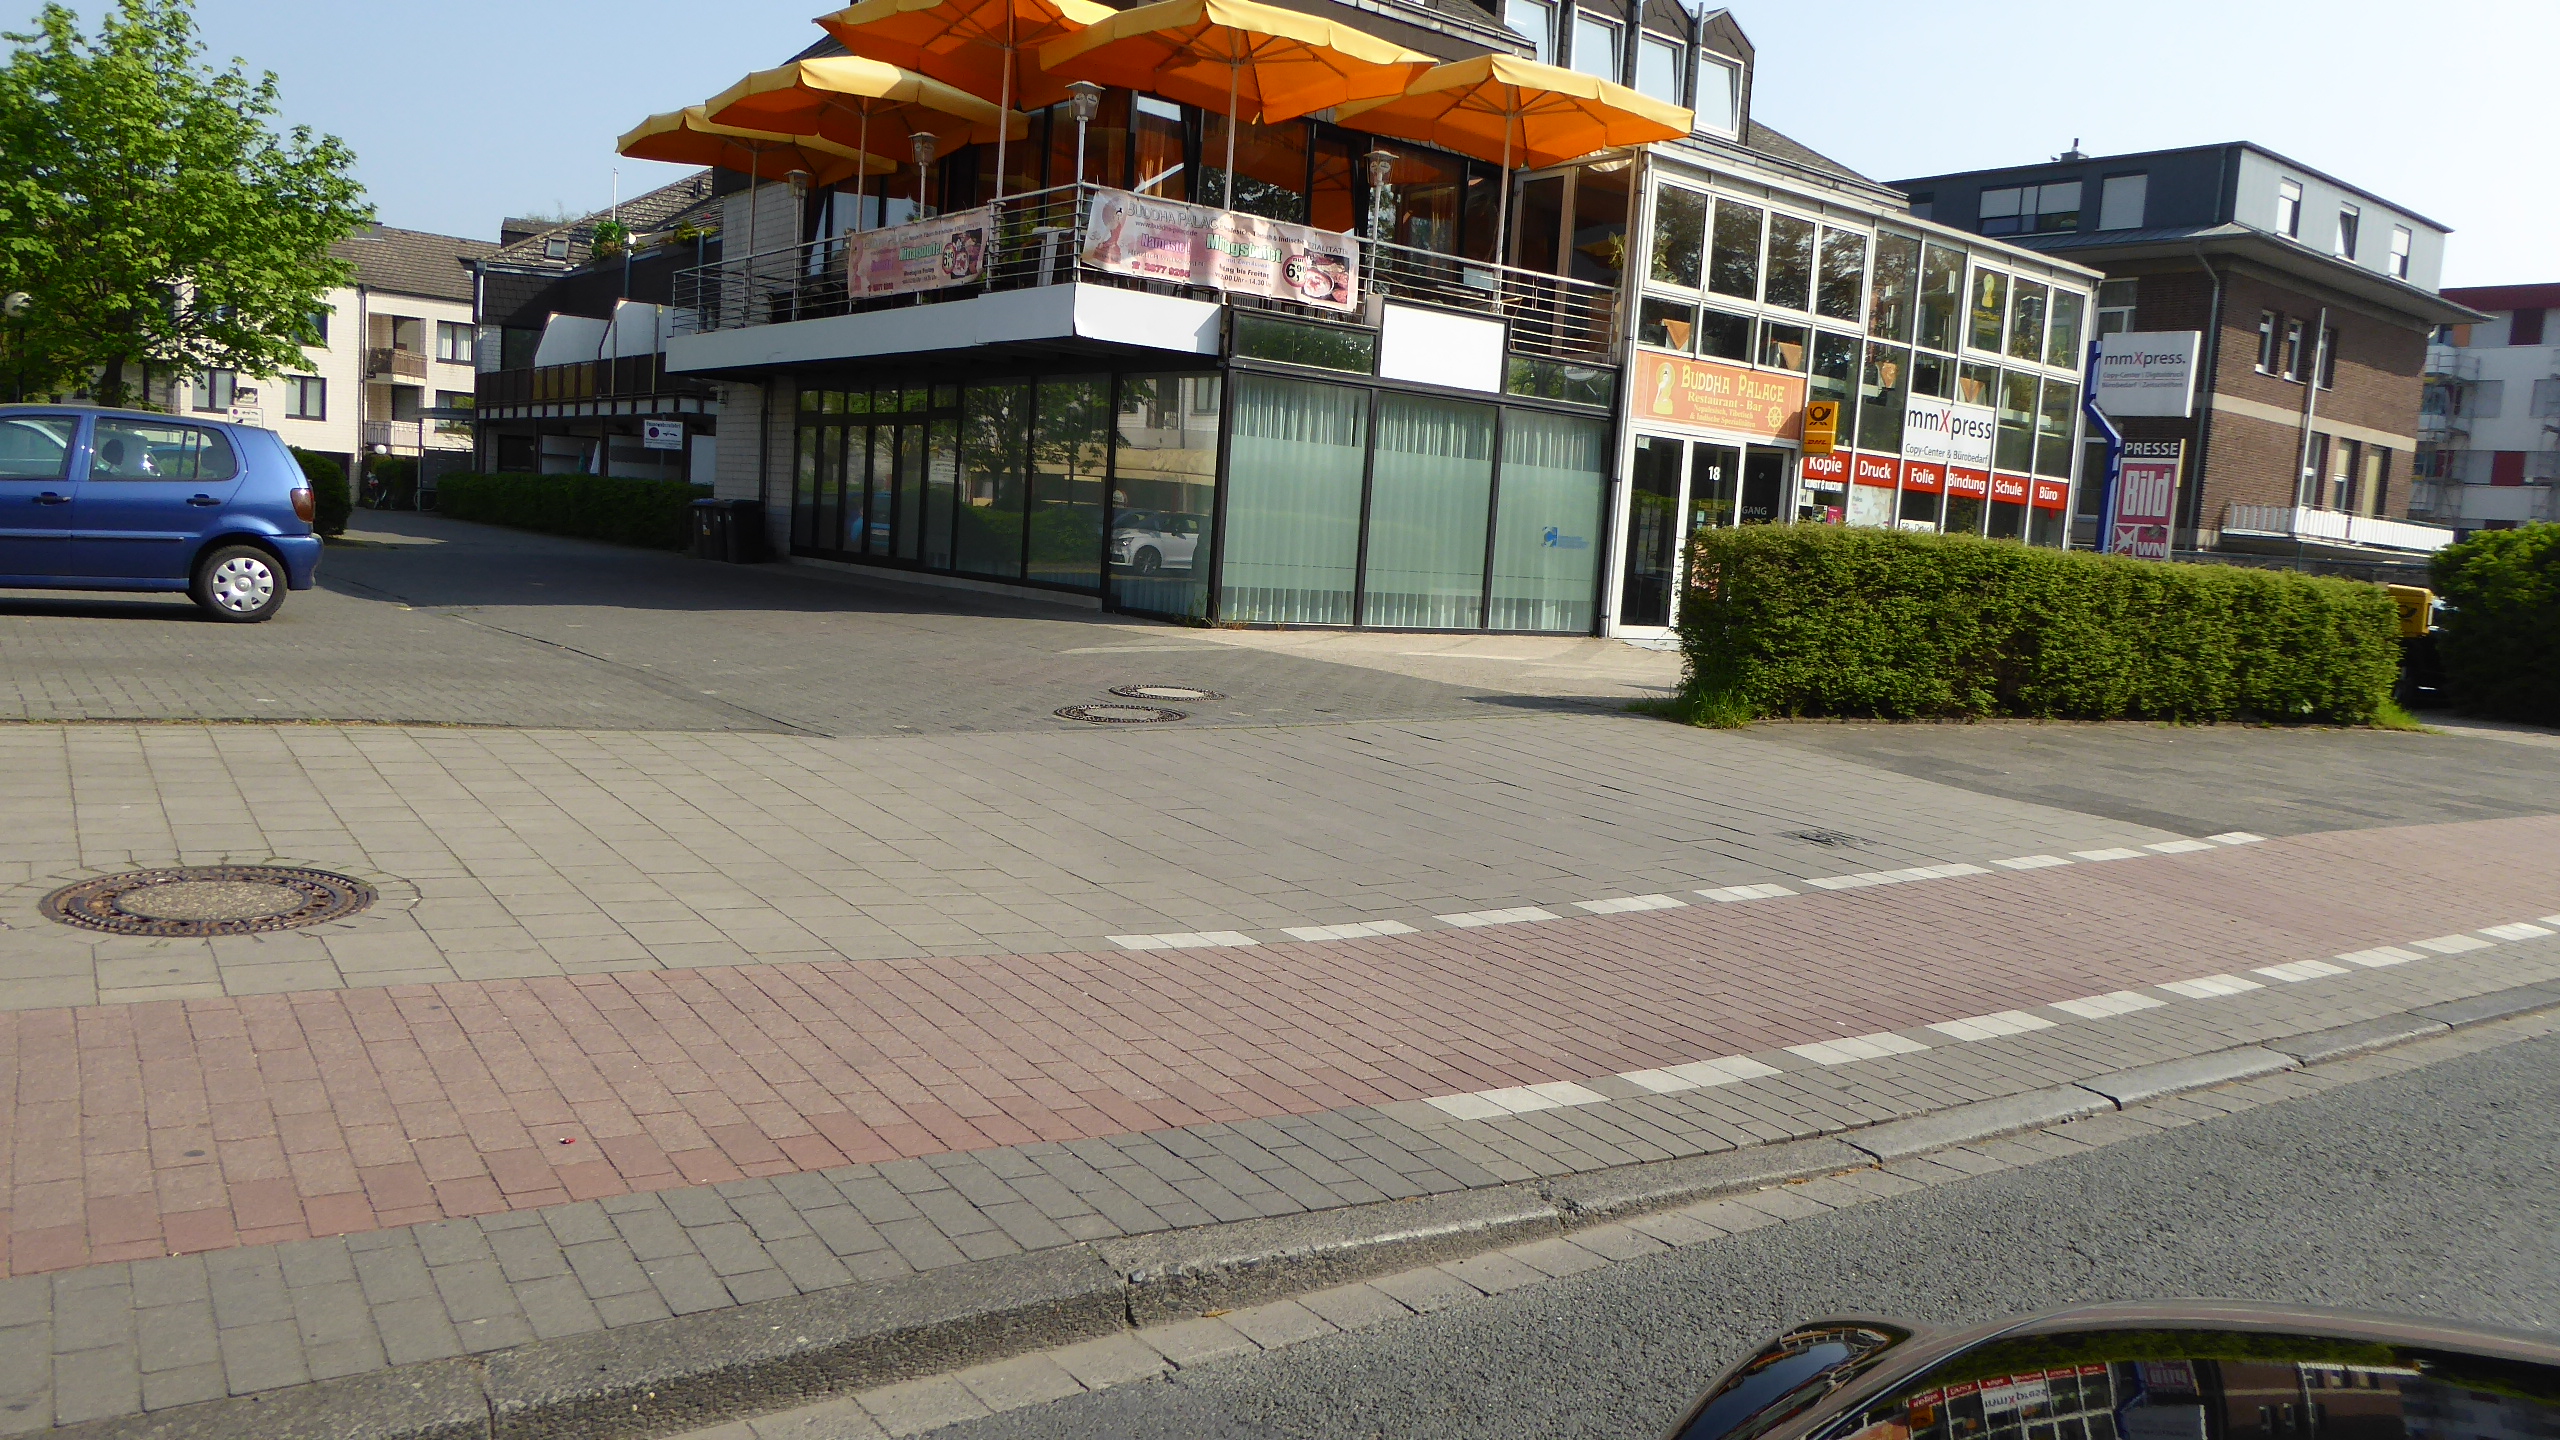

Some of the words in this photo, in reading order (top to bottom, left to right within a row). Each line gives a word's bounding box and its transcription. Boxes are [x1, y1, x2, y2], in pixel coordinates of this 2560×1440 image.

[1127, 201, 1175, 224] BUDDHA
[1177, 211, 1223, 232] PALAC
[1681, 363, 1731, 395] BUDDHA
[1737, 372, 1786, 403] PALACE
[1688, 391, 1738, 409] Restaurant
[1747, 400, 1763, 412] Bar
[1696, 413, 1720, 424] Indische
[1907, 408, 1992, 441] mmXpress
[1905, 443, 1945, 458] Copy-Center
[1947, 450, 1952, 458] &
[1953, 450, 1989, 465] Bürobedarf
[2124, 442, 2179, 456] PRESSE
[1708, 466, 1720, 481] 18
[1808, 456, 1842, 476] Kopie
[1859, 460, 1891, 480] Druck
[1911, 467, 1935, 485] Folie
[1949, 472, 1986, 494] Bindung
[1994, 479, 2023, 497] Schule
[2038, 485, 2058, 501] Büro
[2122, 470, 2171, 517] Bild
[1742, 506, 1767, 515] GANG
[2138, 542, 2166, 557] WN
